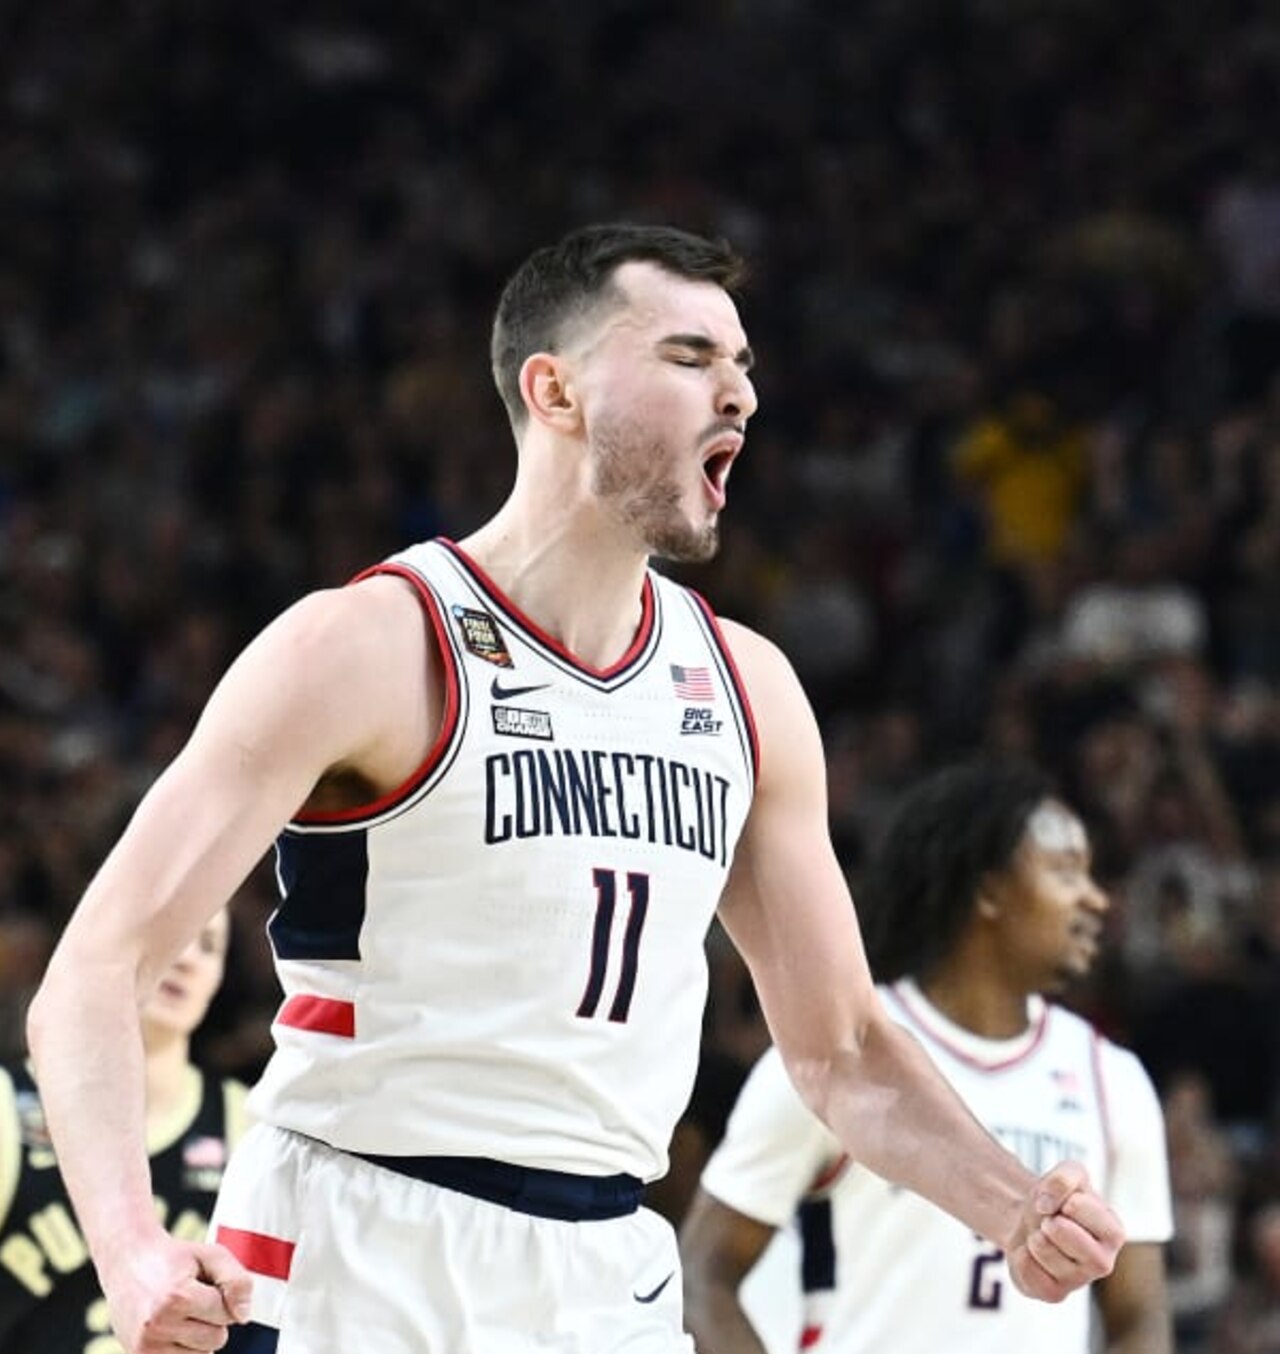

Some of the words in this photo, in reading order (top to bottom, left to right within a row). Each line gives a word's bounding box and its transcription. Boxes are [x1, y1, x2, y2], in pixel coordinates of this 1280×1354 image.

[681, 720, 723, 733] EAST
[684, 707, 712, 720] BIG
[485, 748, 731, 868] CONNECTICUT
[576, 867, 650, 1024] 11
